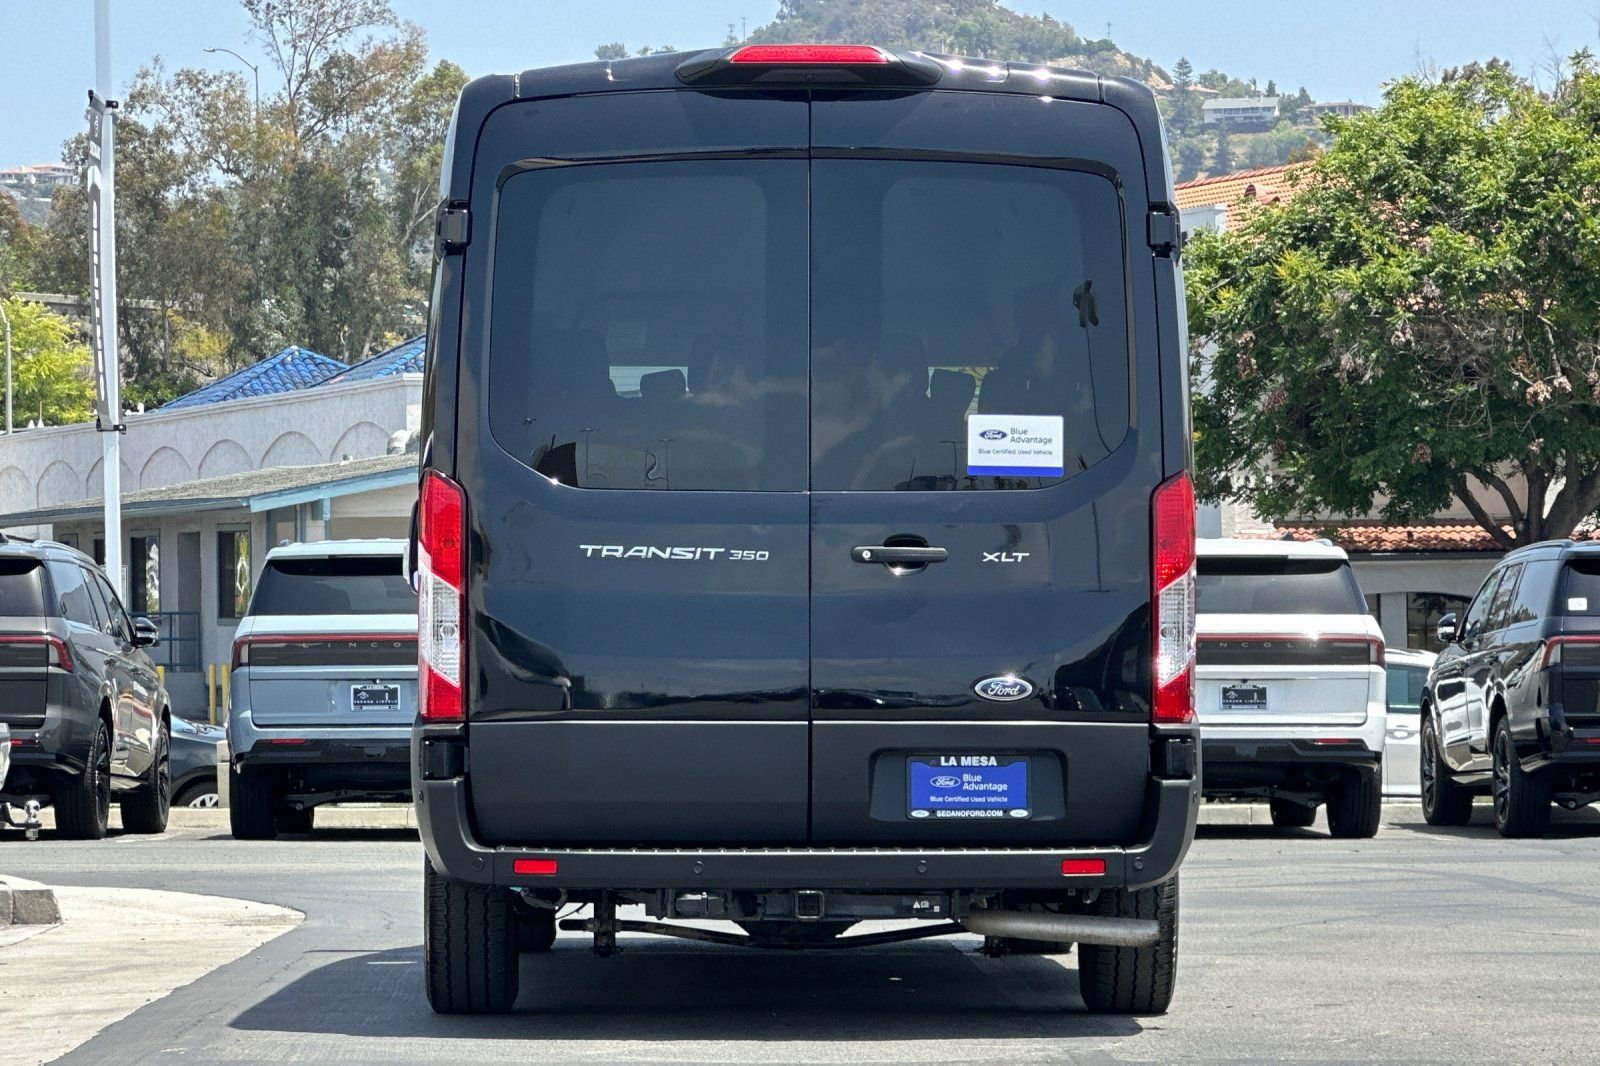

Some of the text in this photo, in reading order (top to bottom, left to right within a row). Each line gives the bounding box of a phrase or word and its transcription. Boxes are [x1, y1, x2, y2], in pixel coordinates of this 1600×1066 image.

[1010, 427, 1029, 435] Blue
[1010, 436, 1053, 445] Advantage
[579, 544, 769, 561] TRANSIT 350
[982, 552, 1030, 563] XLT
[940, 756, 998, 766] LA MESA
[962, 773, 982, 782] Blue
[962, 783, 1008, 792] Advantage
[936, 809, 1003, 817] SEDANOFORD.COM
